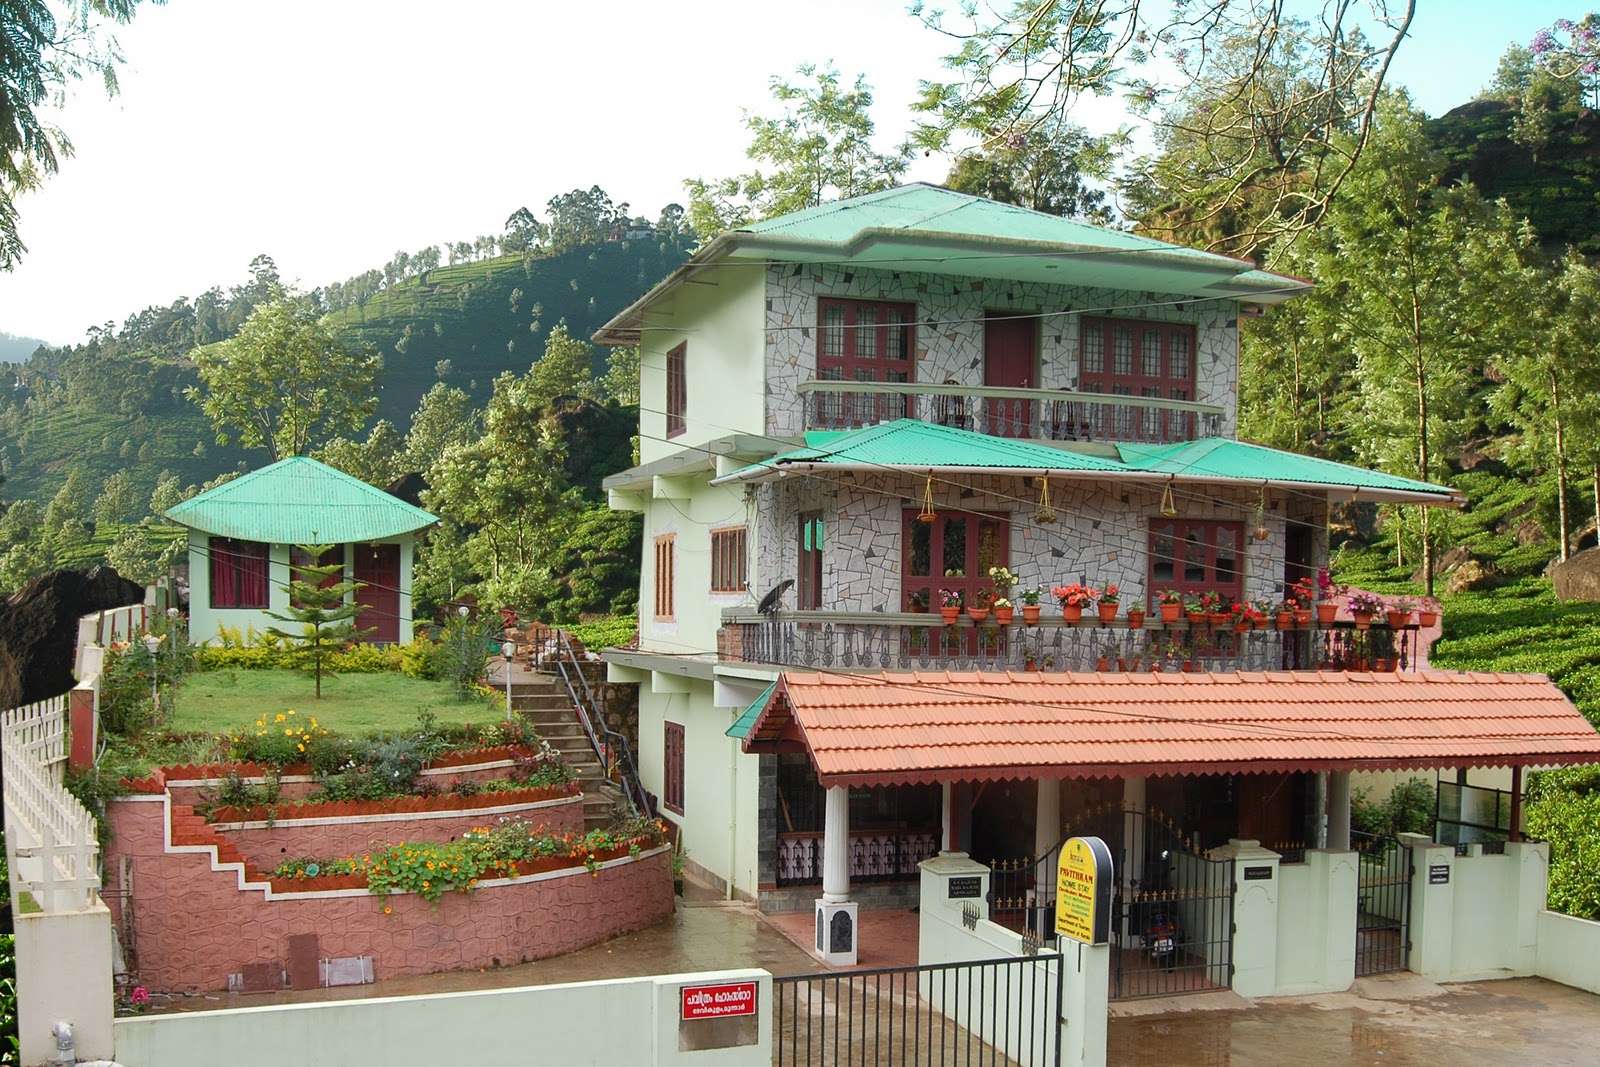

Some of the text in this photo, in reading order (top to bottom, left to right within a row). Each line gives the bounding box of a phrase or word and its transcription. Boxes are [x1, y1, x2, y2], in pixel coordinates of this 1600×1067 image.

[1060, 868, 1093, 884] PAVITHRAM
[1062, 879, 1090, 894] HOME STAY
